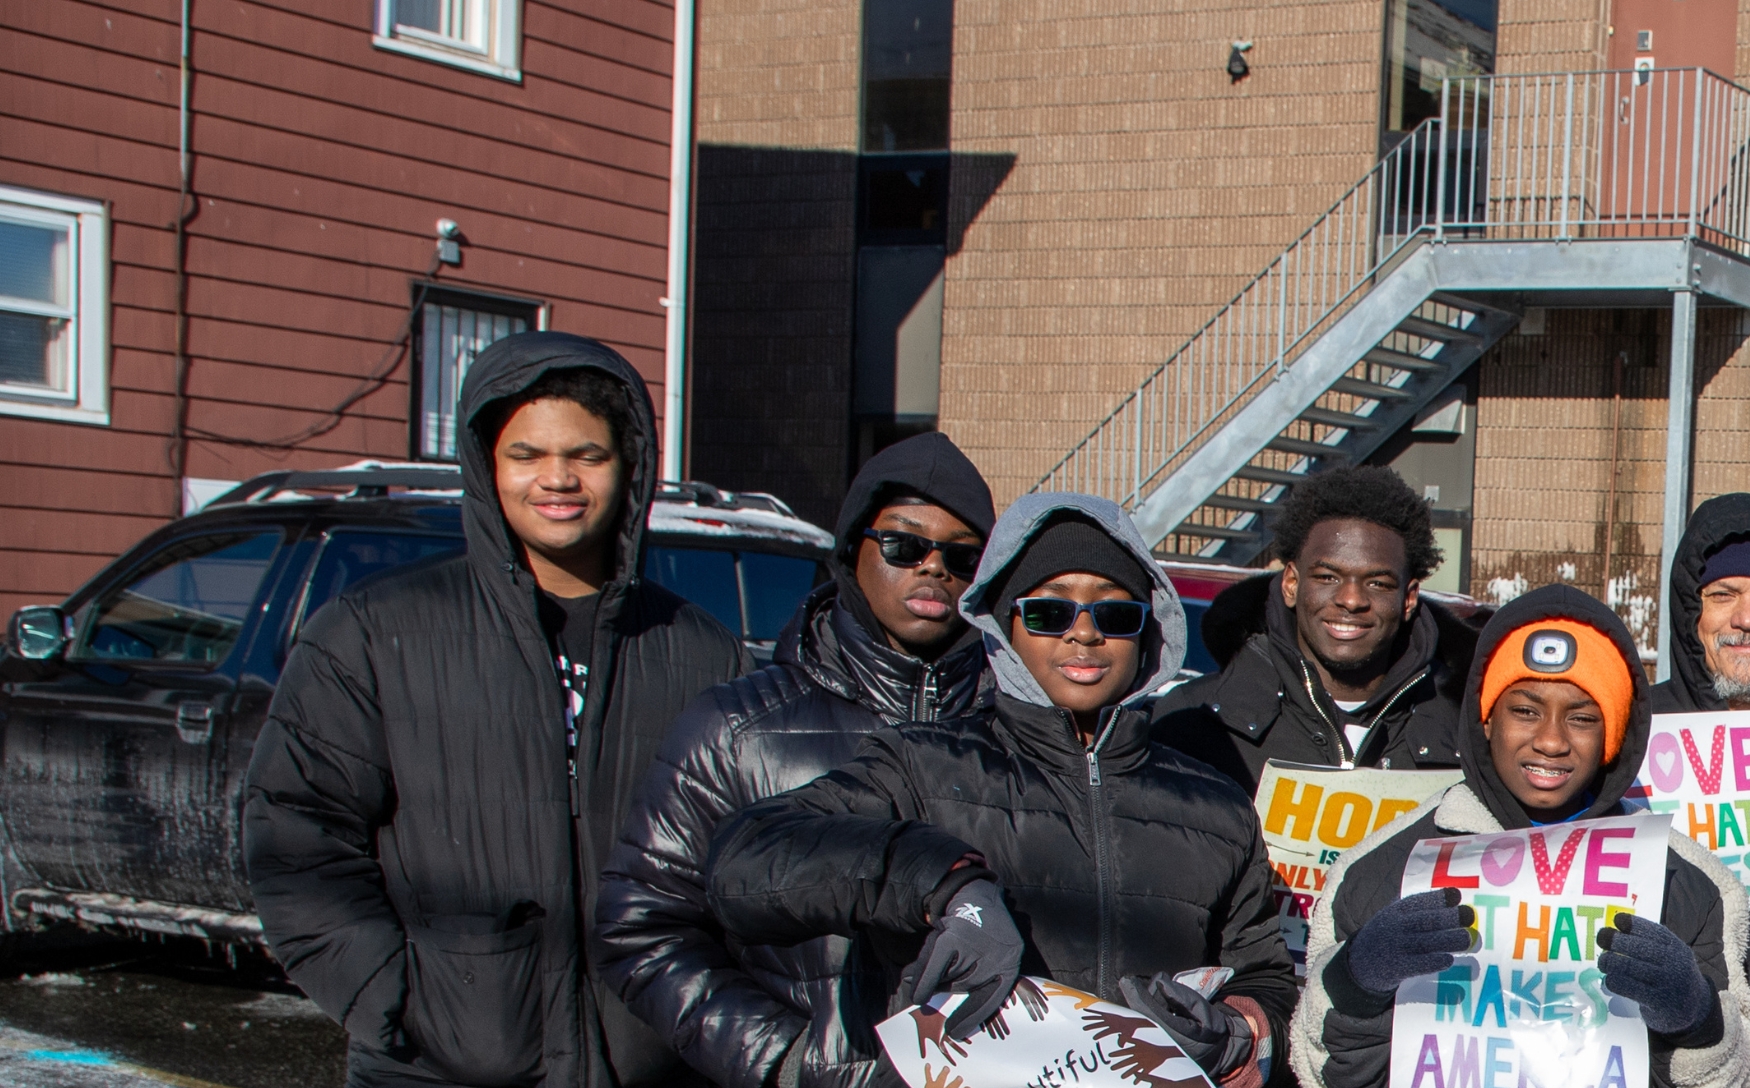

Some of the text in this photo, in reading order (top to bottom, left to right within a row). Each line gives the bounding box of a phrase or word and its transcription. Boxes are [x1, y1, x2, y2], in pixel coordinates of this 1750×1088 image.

[1319, 849, 1341, 865] IS
[1424, 827, 1637, 906] LOVE,
[1435, 965, 1608, 1029] MAKES
